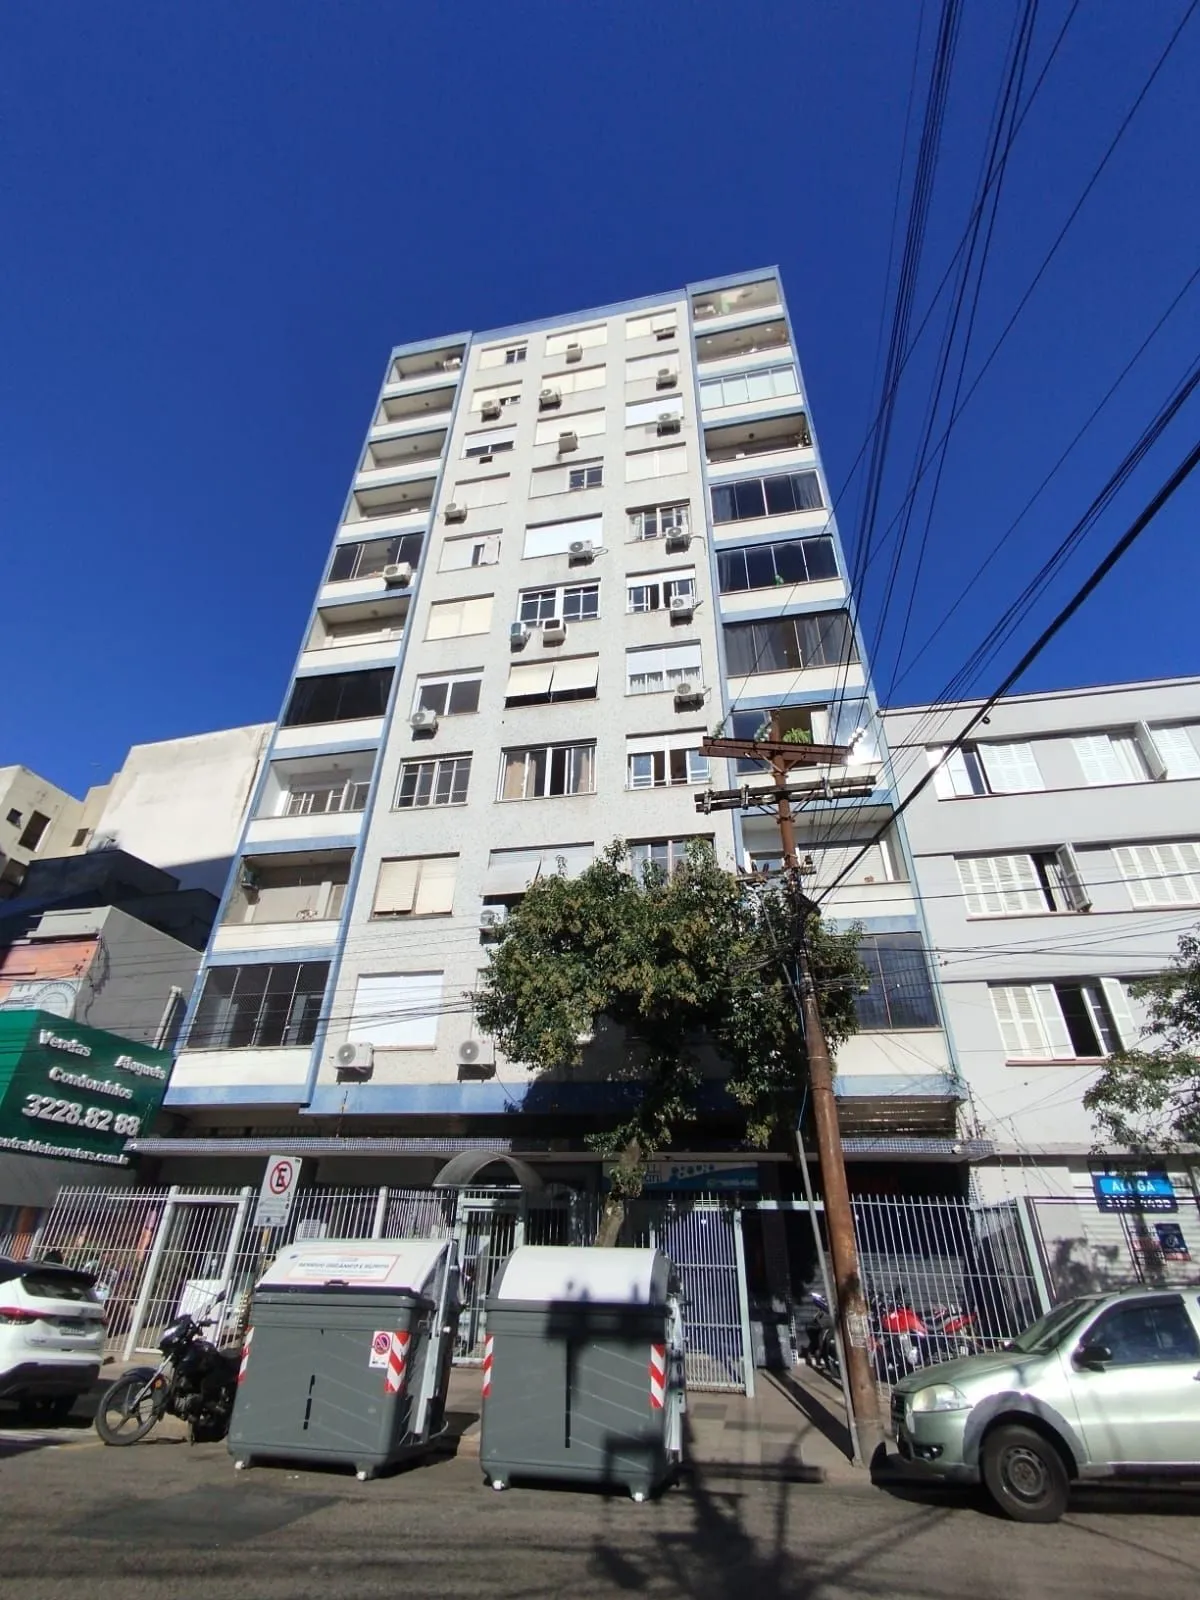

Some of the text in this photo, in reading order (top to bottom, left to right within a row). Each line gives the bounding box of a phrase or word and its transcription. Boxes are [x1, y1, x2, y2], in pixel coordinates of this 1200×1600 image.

[40, 1029, 92, 1057] Vendas
[22, 1094, 141, 1136] 3228.82 88
